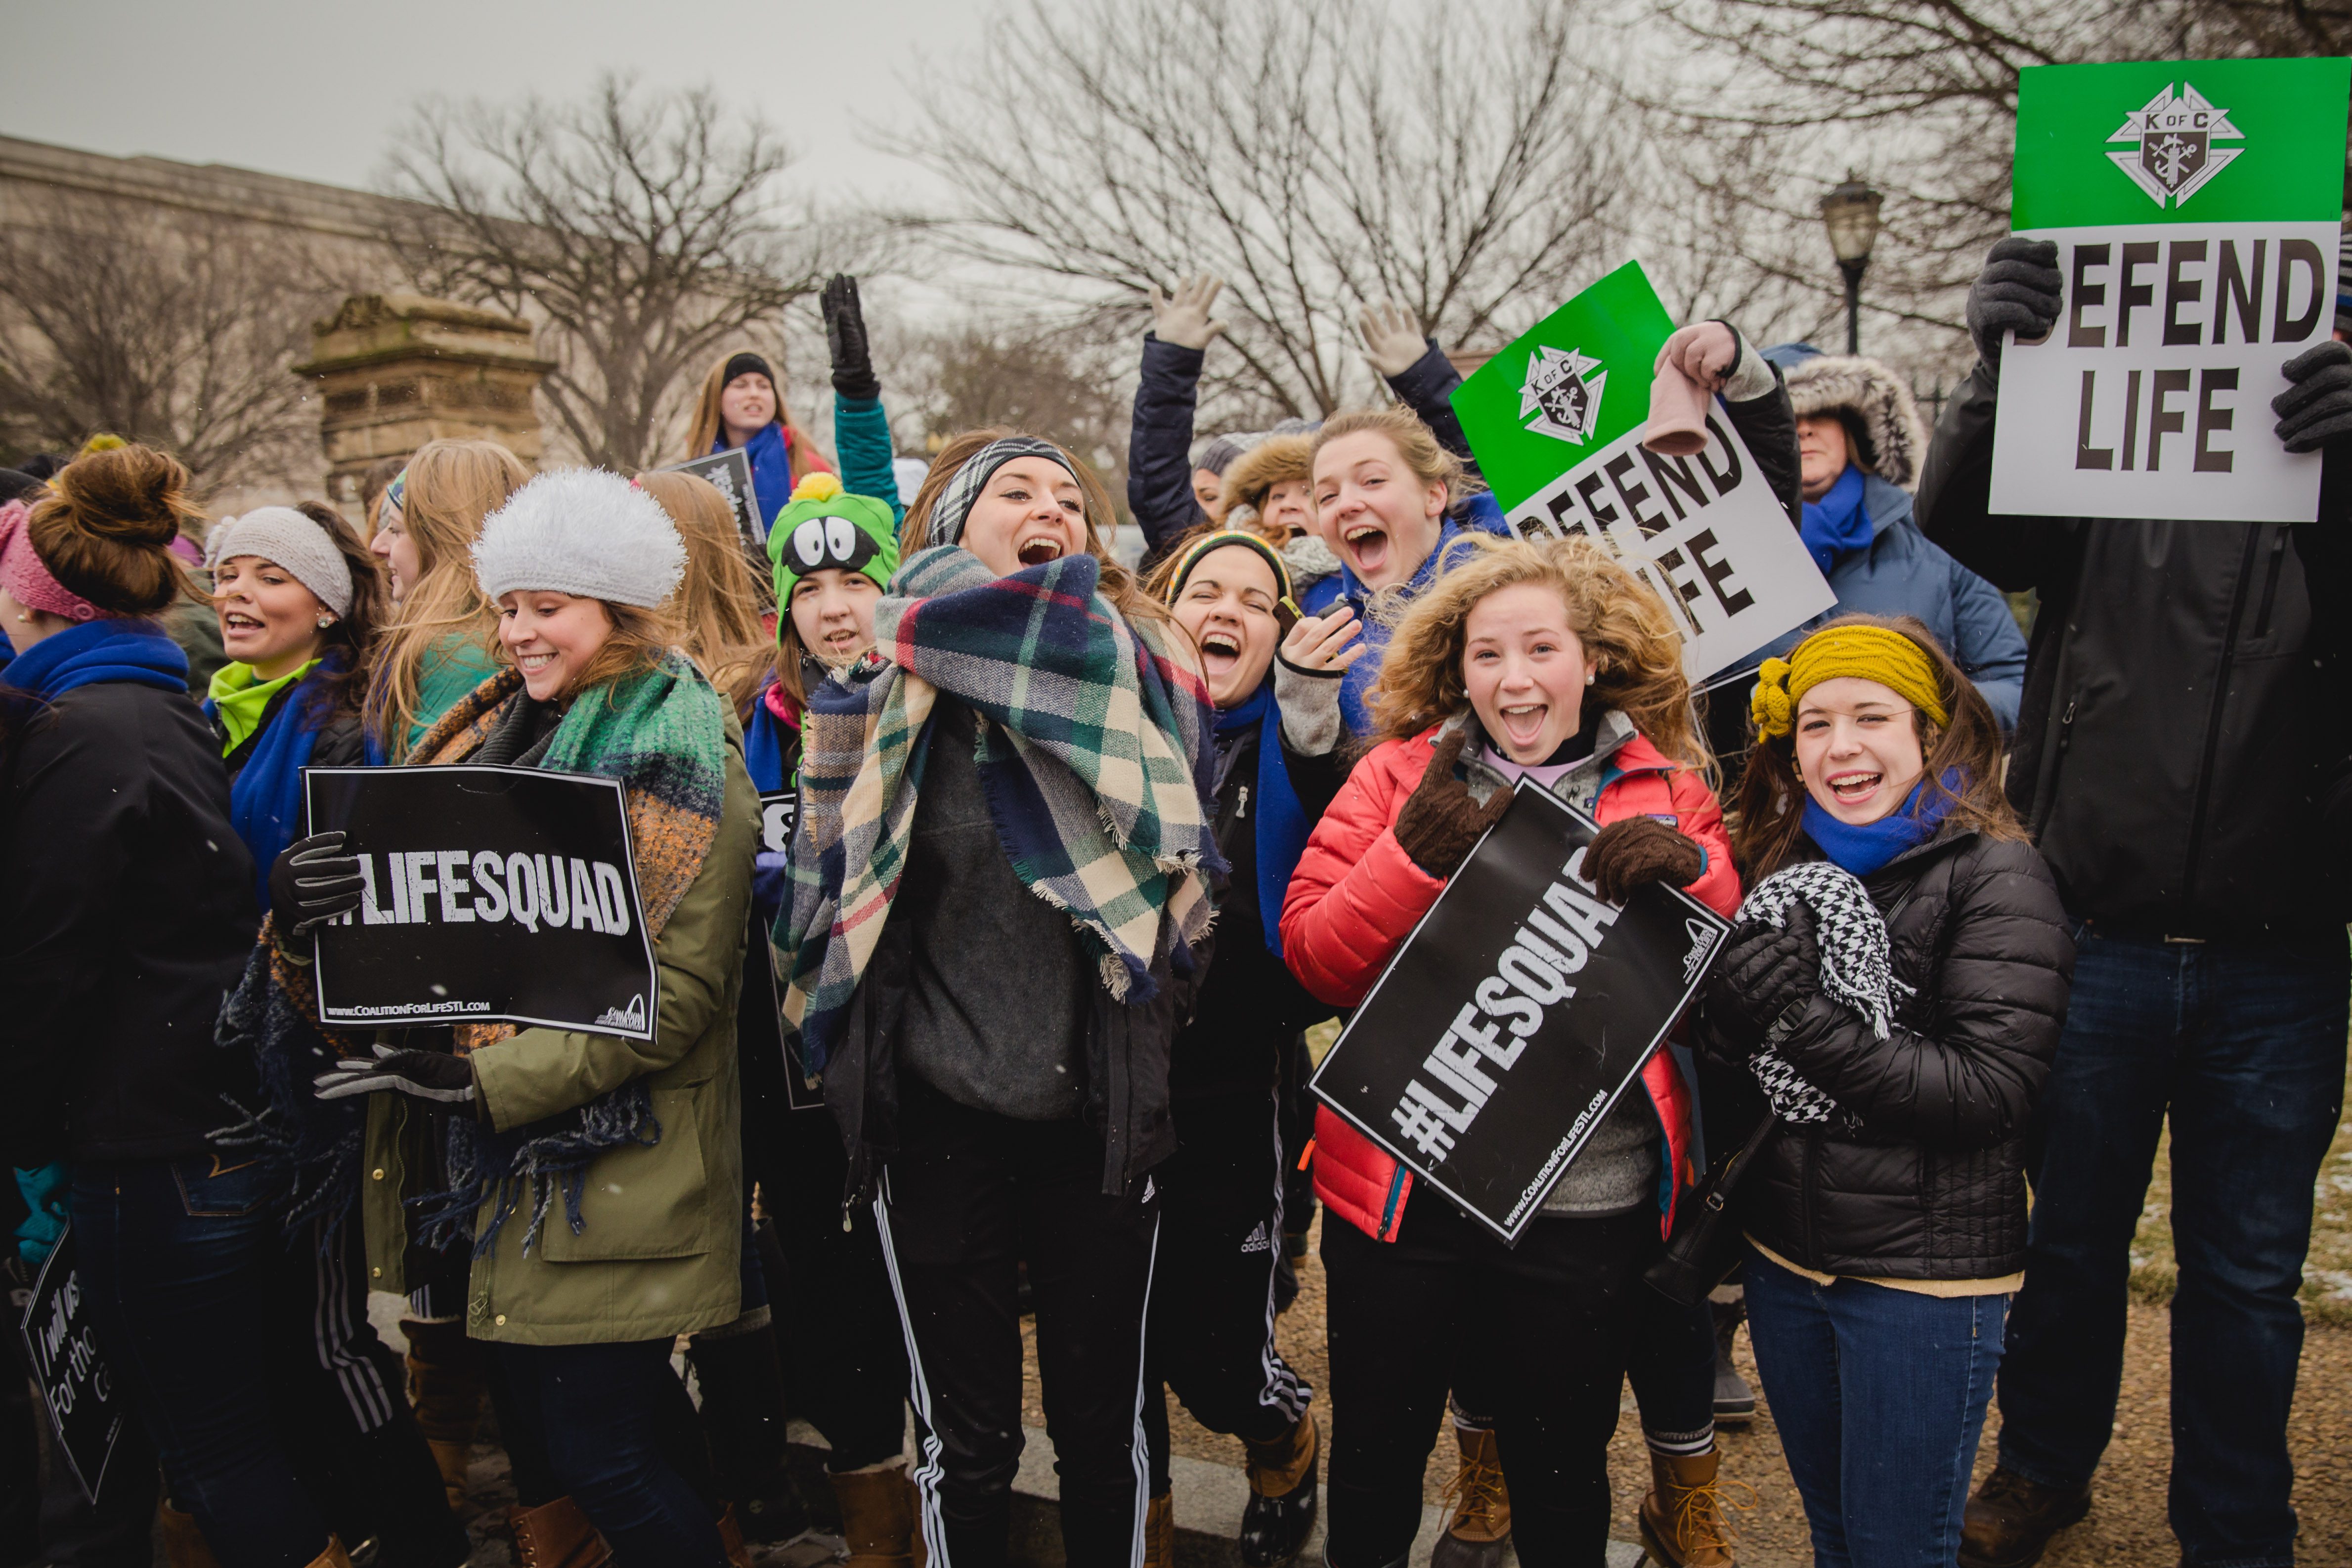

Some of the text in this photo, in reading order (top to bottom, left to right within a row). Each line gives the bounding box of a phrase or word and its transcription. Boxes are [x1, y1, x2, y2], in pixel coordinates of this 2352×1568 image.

[2145, 113, 2208, 130] K OF C
[2013, 239, 2325, 349] EFEND
[1531, 359, 1572, 395] K OF C
[2075, 367, 2240, 473] LIFE
[1635, 527, 1755, 645] FE
[328, 851, 630, 936] LIFESQUAD
[49, 1368, 76, 1431] For
